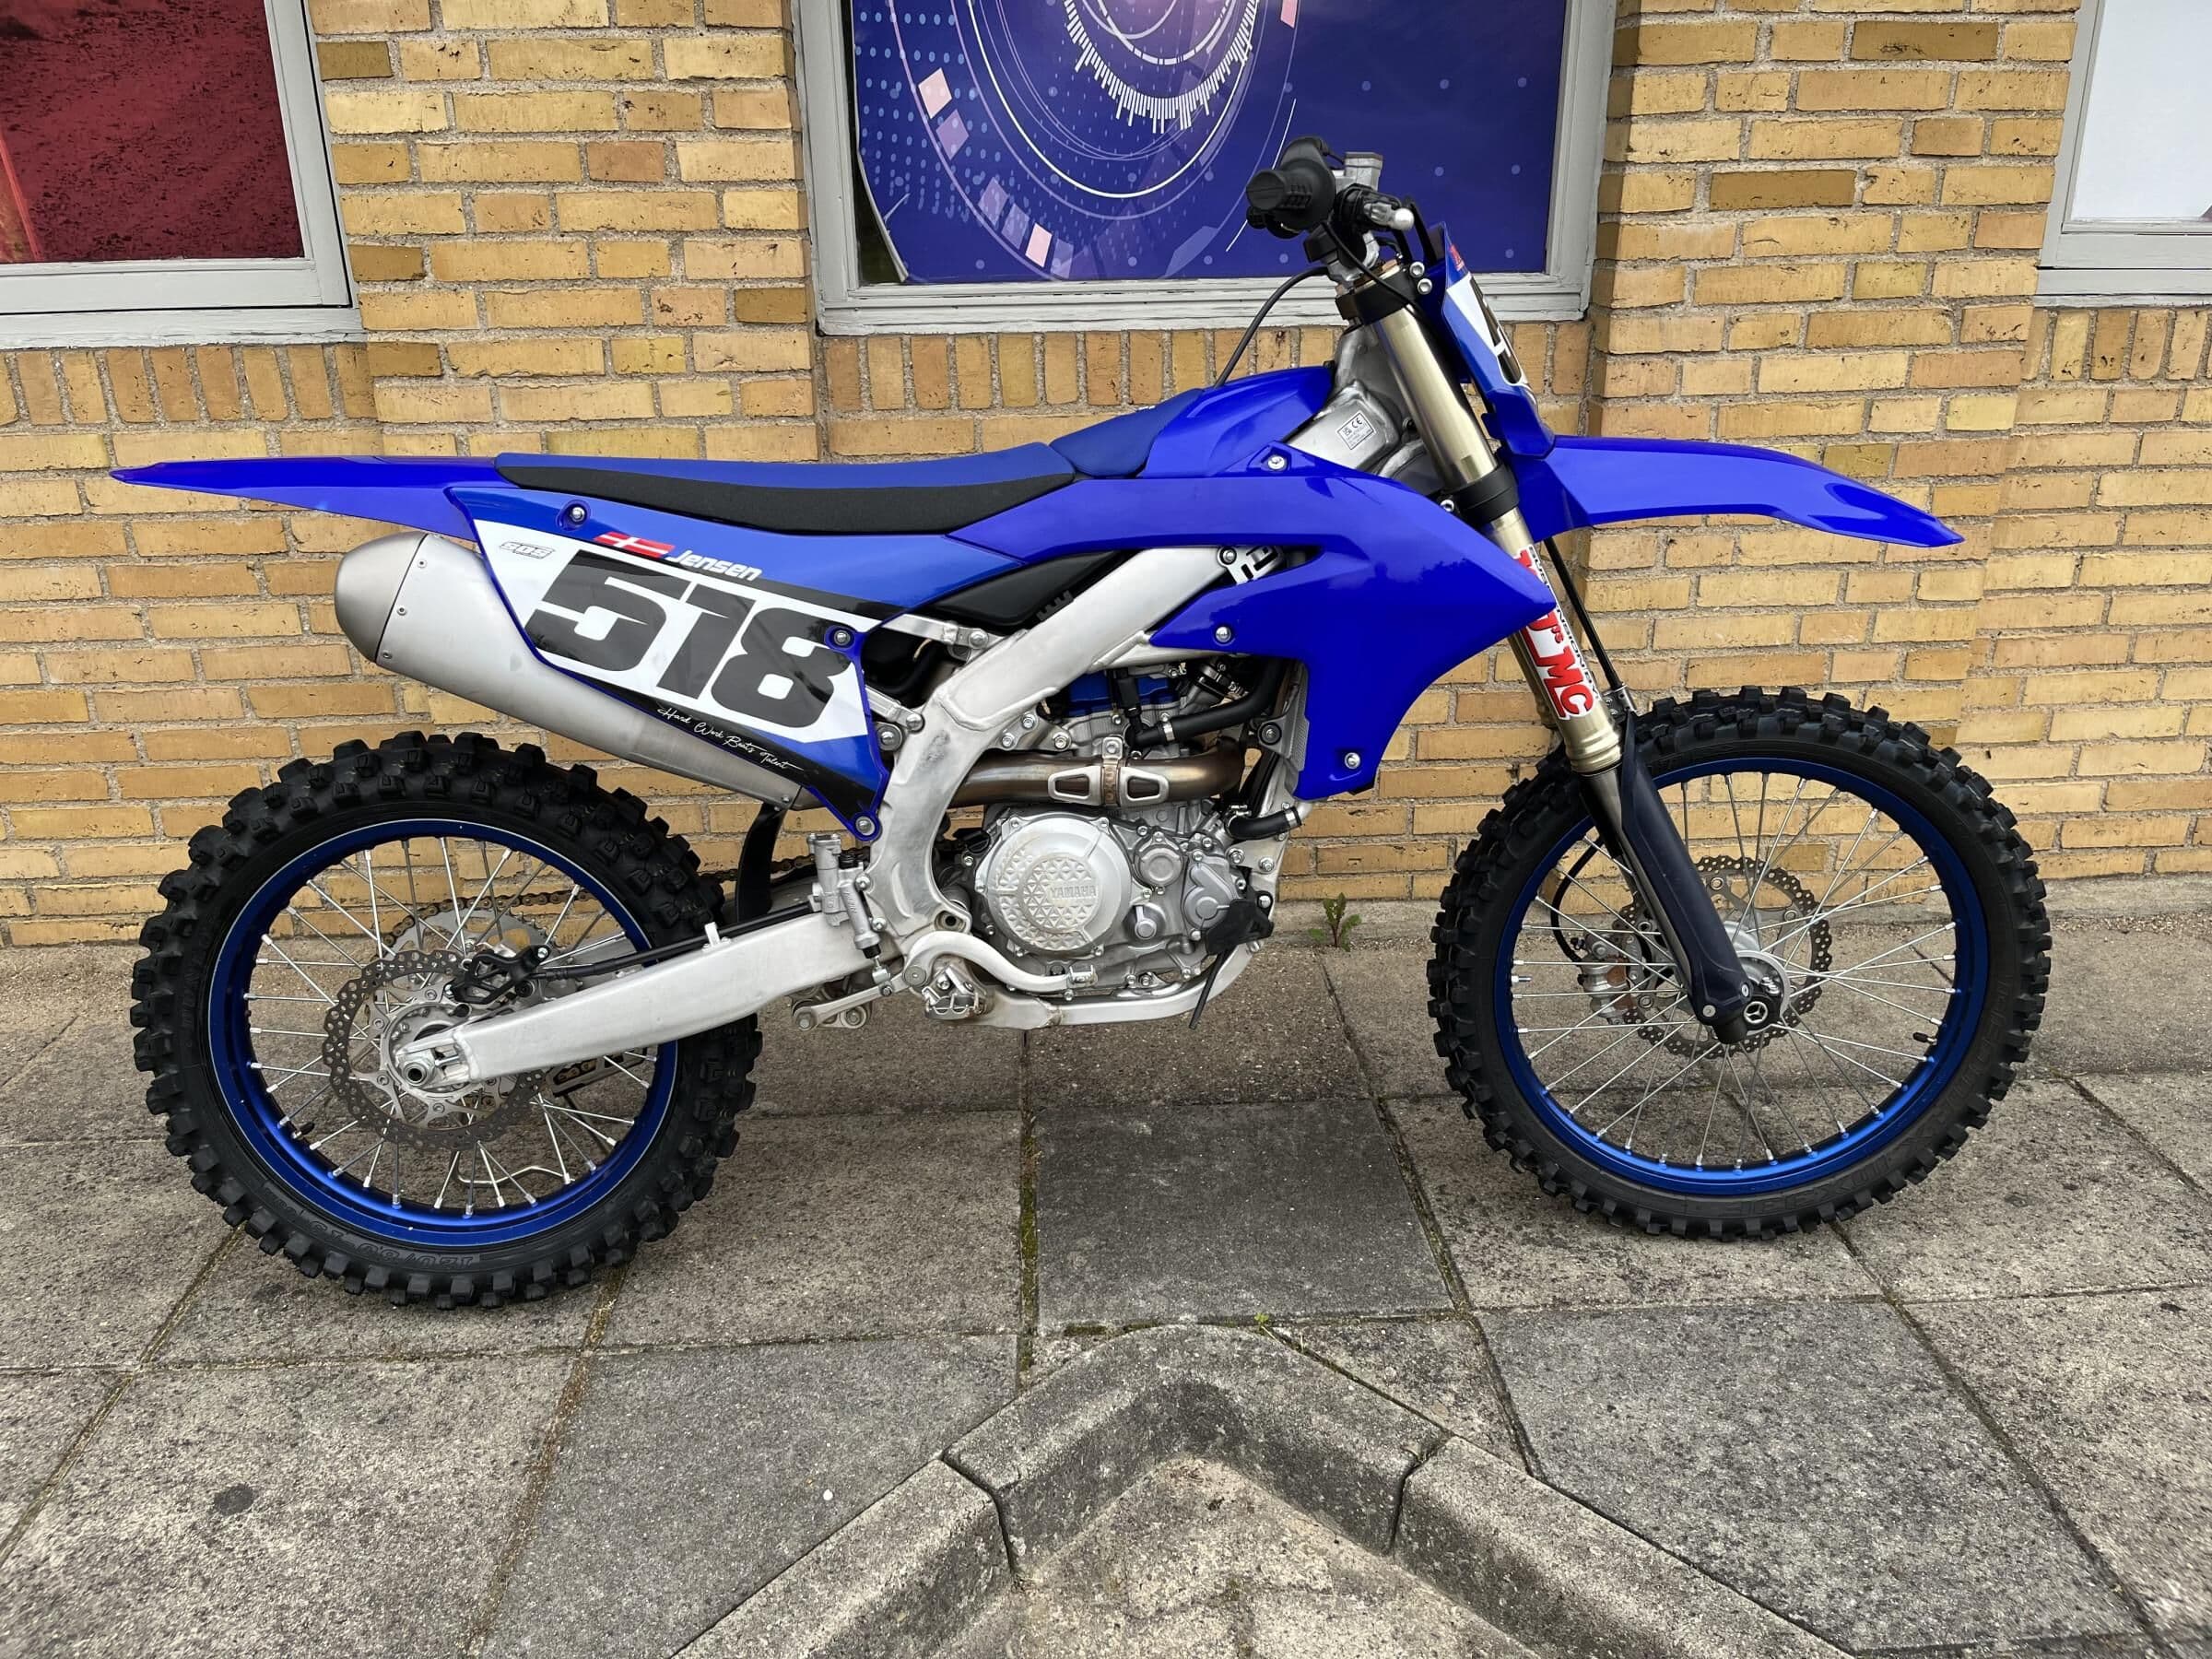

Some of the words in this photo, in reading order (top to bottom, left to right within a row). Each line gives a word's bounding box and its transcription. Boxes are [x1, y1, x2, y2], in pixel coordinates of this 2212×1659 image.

[665, 548, 763, 582] Jensen
[524, 549, 853, 728] 518
[1536, 646, 1594, 718] MC
[656, 706, 692, 724] Hard
[694, 722, 724, 739] Work
[724, 735, 767, 753] Beats
[759, 752, 804, 771] Talent
[1050, 885, 1098, 900] YAMAHA
